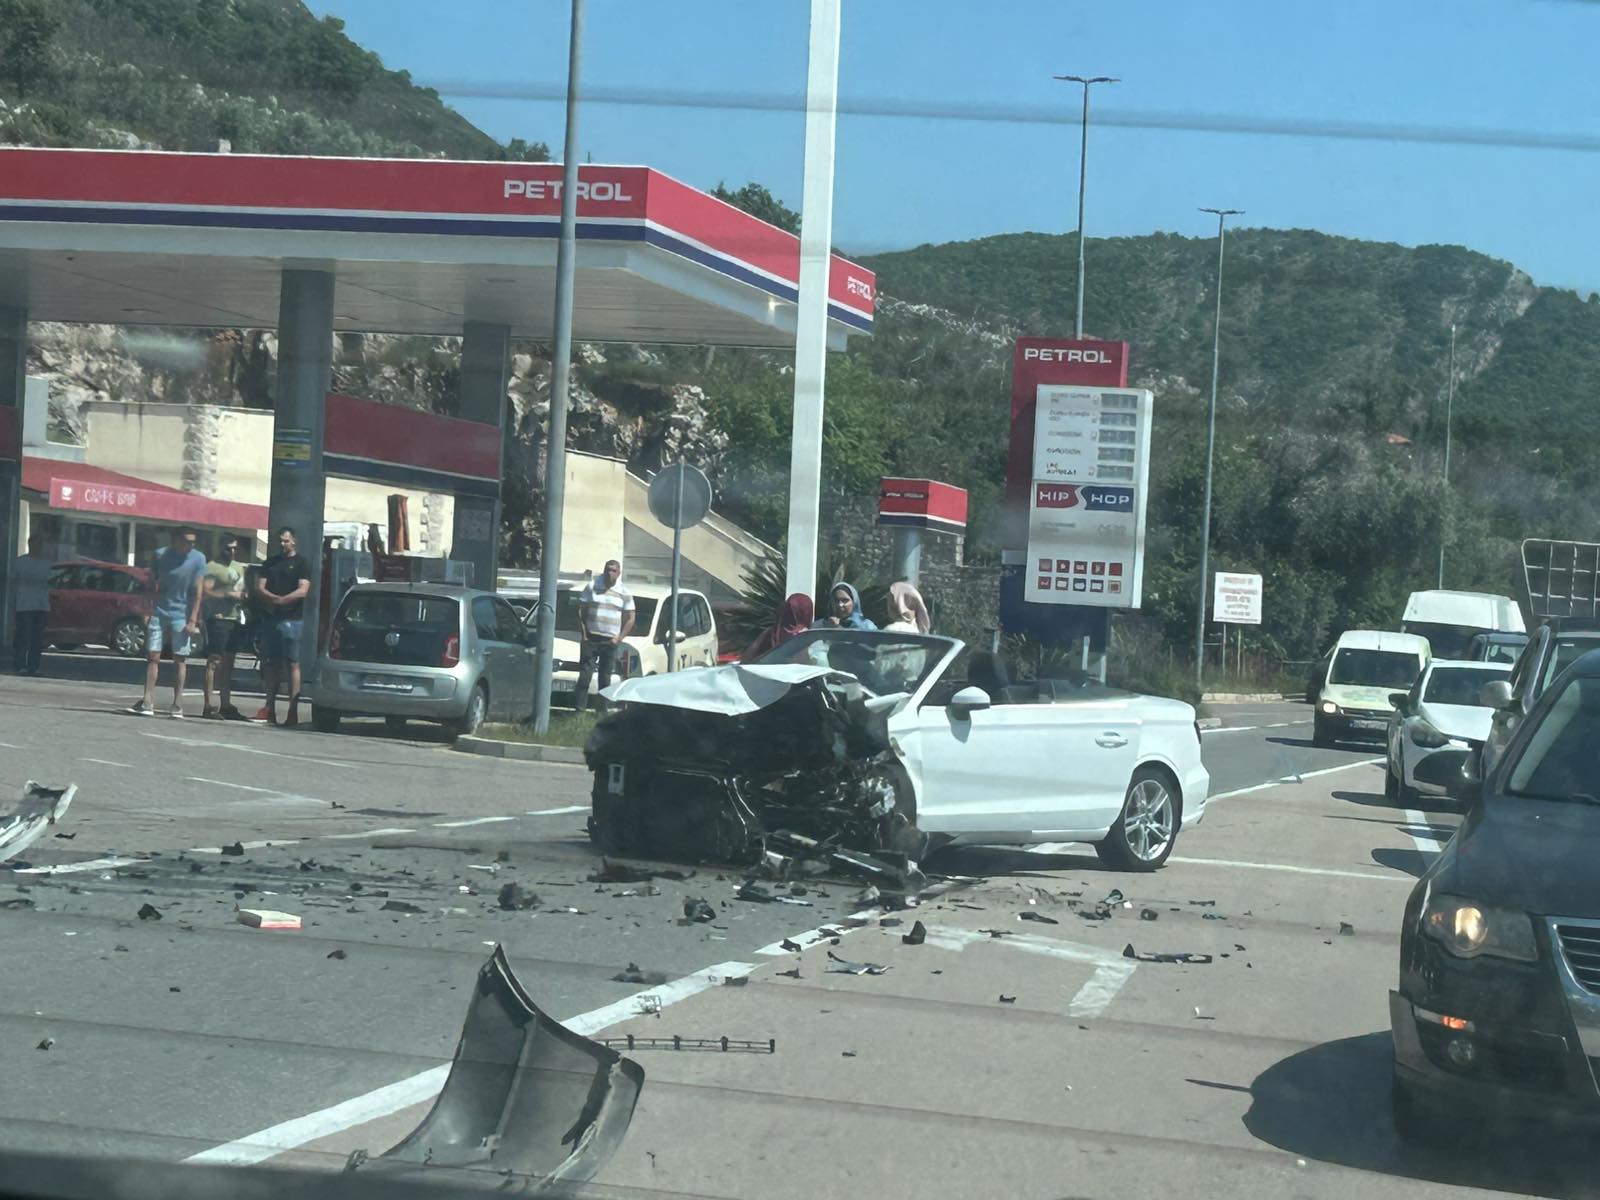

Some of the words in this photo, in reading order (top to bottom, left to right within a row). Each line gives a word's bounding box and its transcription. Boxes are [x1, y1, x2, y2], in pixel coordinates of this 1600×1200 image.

[503, 179, 633, 202] PETROL
[1024, 348, 1112, 364] PETROL
[1039, 491, 1070, 502] HIP
[1091, 494, 1130, 505] HOP
